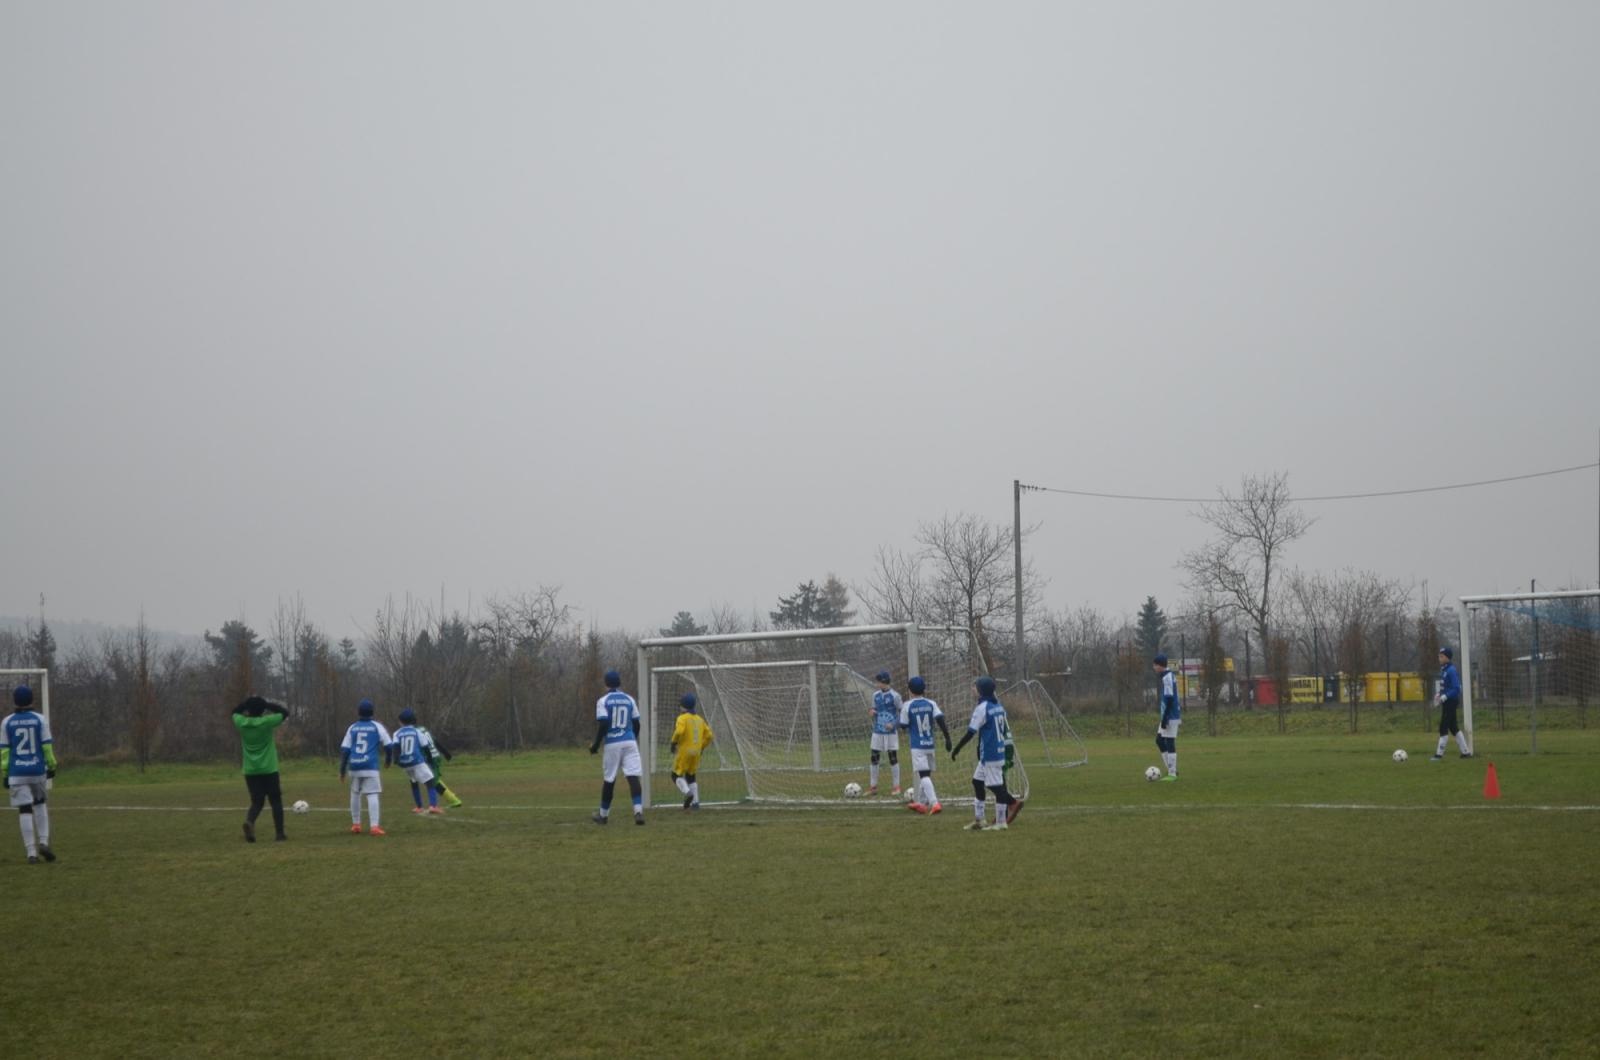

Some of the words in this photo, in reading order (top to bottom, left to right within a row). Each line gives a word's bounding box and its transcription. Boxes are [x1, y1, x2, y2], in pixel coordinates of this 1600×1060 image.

[611, 706, 628, 729] 10
[916, 714, 931, 738] 14
[15, 727, 36, 756] 21
[355, 732, 369, 754] 5
[400, 736, 415, 755] 10
